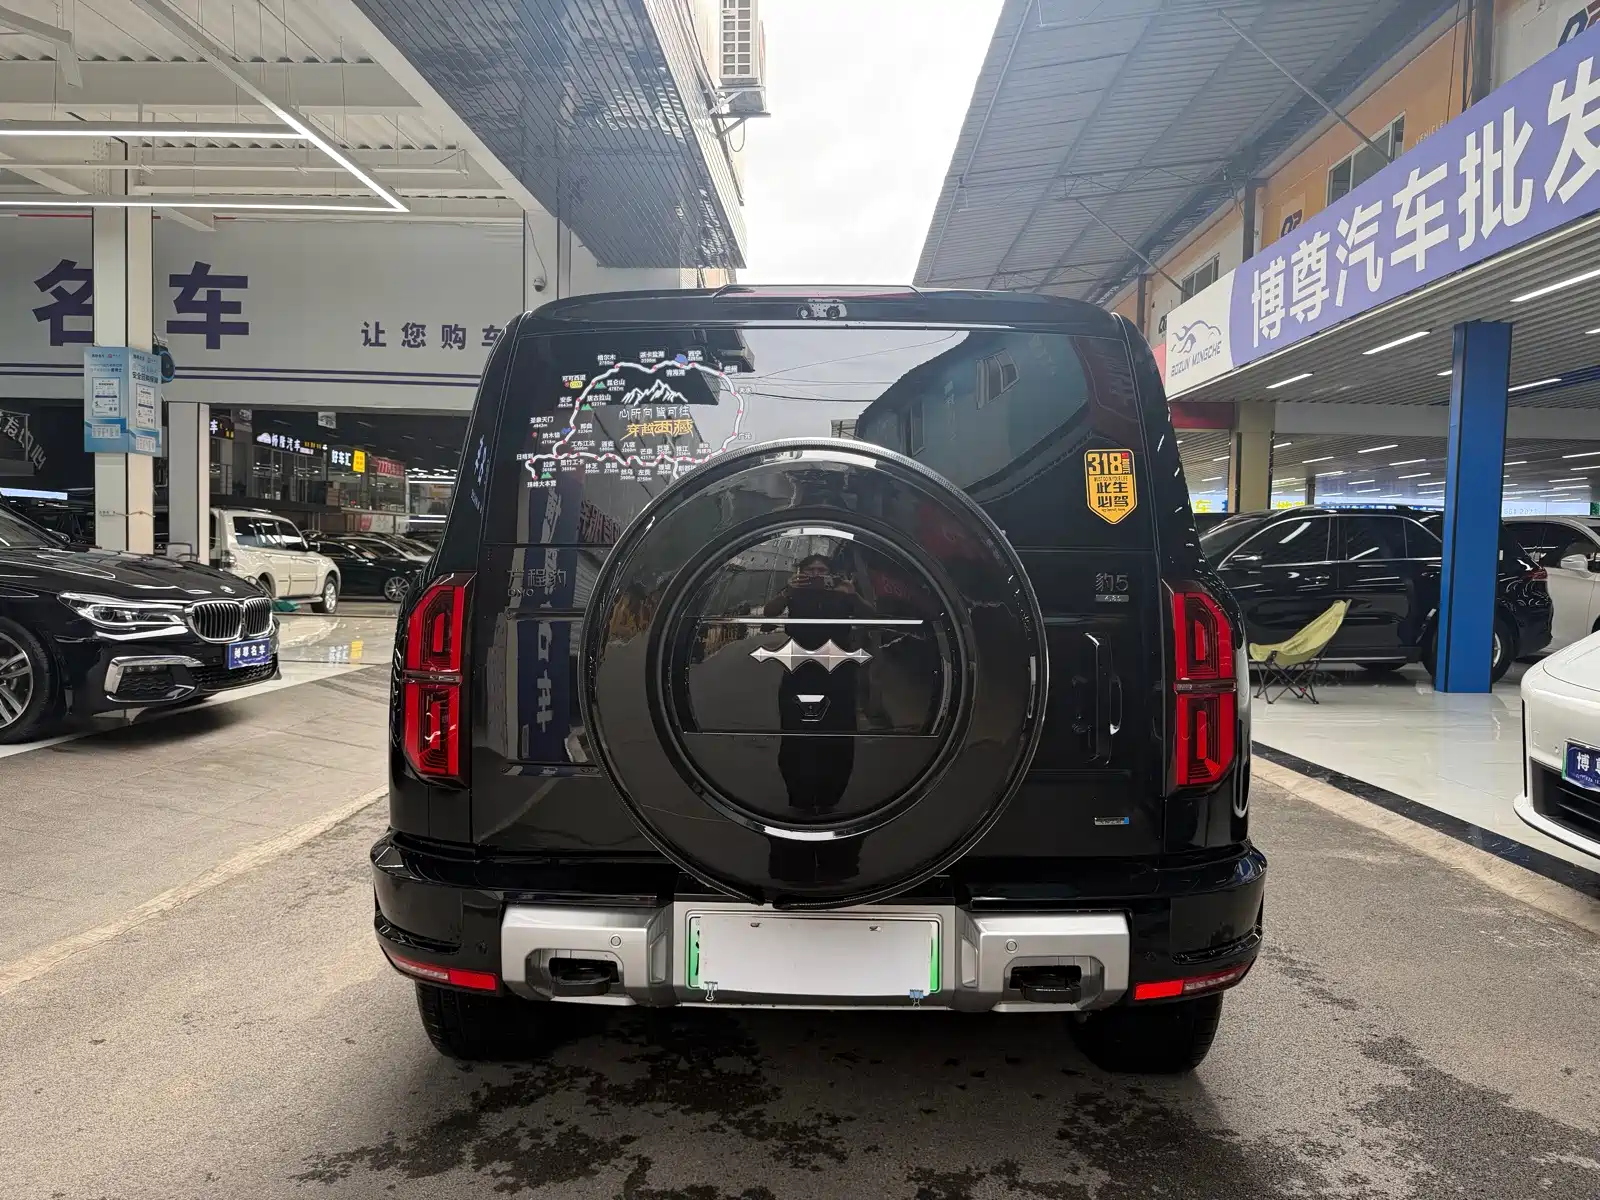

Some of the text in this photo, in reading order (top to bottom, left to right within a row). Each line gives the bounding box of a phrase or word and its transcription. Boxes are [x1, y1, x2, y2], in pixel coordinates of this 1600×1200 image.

[1251, 56, 1600, 347] 博尊汽车批发
[32, 259, 249, 349] 名车
[618, 406, 653, 420] 心所向
[1087, 452, 1123, 475] 318
[1097, 482, 1129, 493] 此生
[1098, 496, 1129, 508] 必驾
[507, 568, 567, 588] 方程豹
